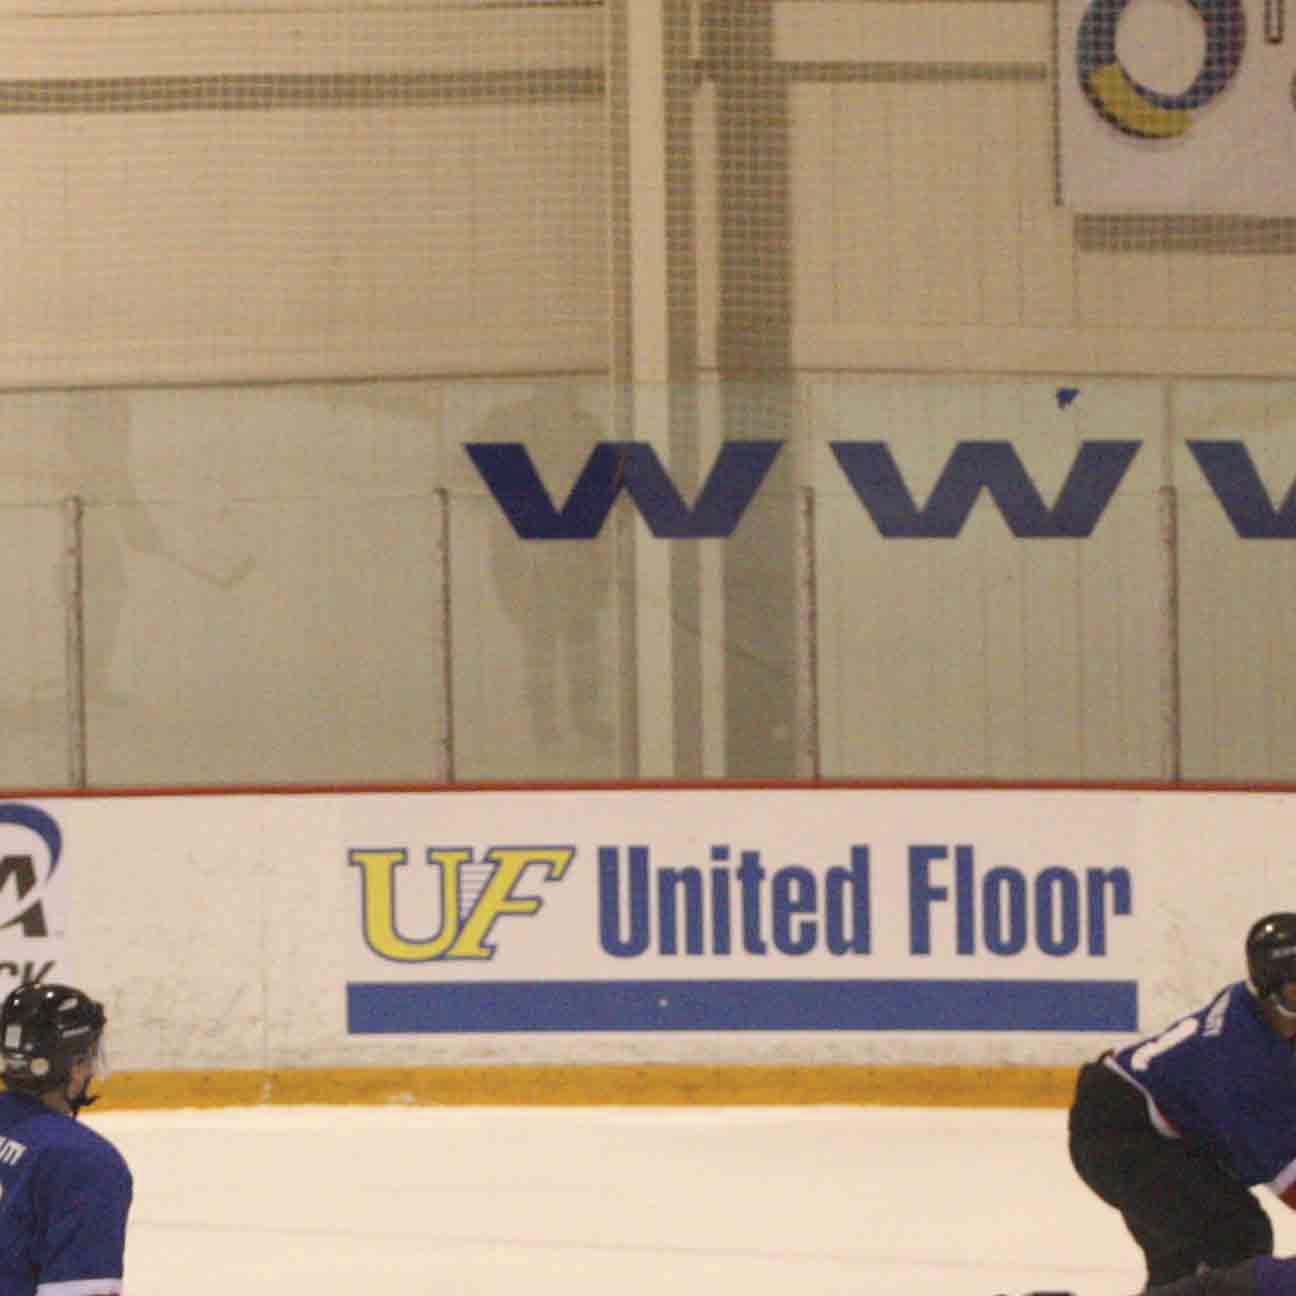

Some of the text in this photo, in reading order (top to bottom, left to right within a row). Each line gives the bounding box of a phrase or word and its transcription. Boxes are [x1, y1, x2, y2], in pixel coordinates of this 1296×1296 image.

[348, 846, 576, 962] UF
[597, 845, 1133, 957] United Floor
